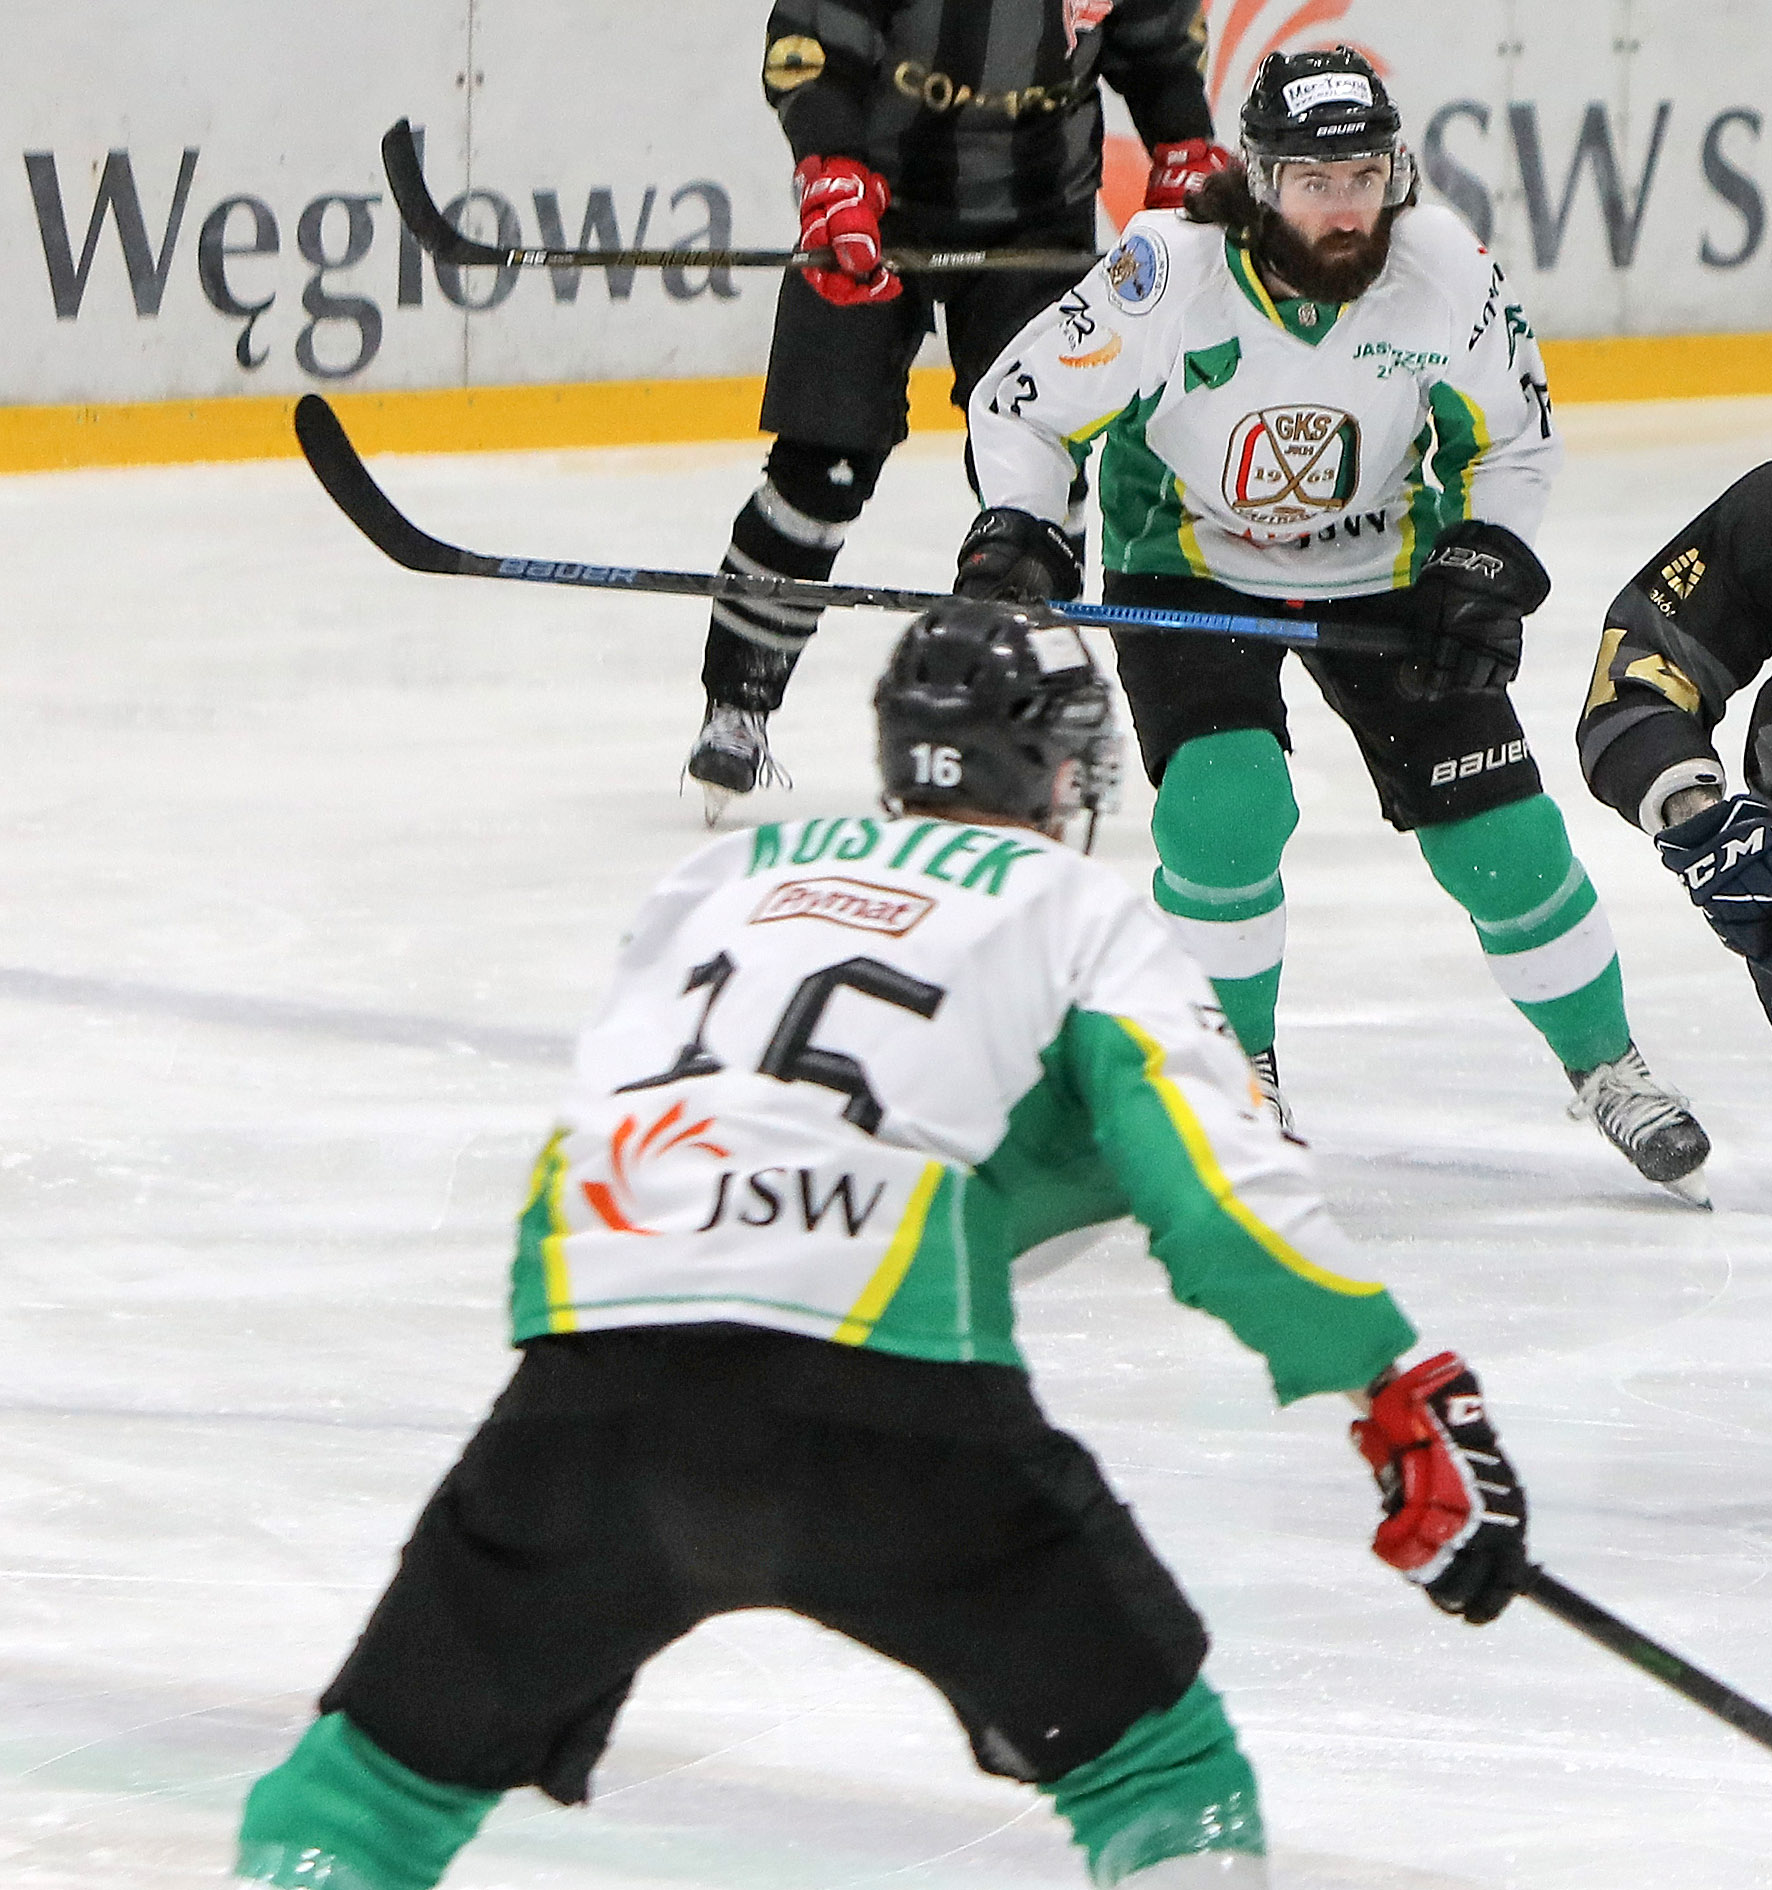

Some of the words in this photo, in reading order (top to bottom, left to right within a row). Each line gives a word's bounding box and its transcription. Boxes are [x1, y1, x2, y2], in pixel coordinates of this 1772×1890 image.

[1422, 98, 1673, 270] SW
[23, 125, 741, 379] Węglowa
[1275, 412, 1332, 441] GKS
[498, 558, 638, 585] BAUER
[909, 743, 962, 789] 16
[697, 1167, 887, 1237] JSW
